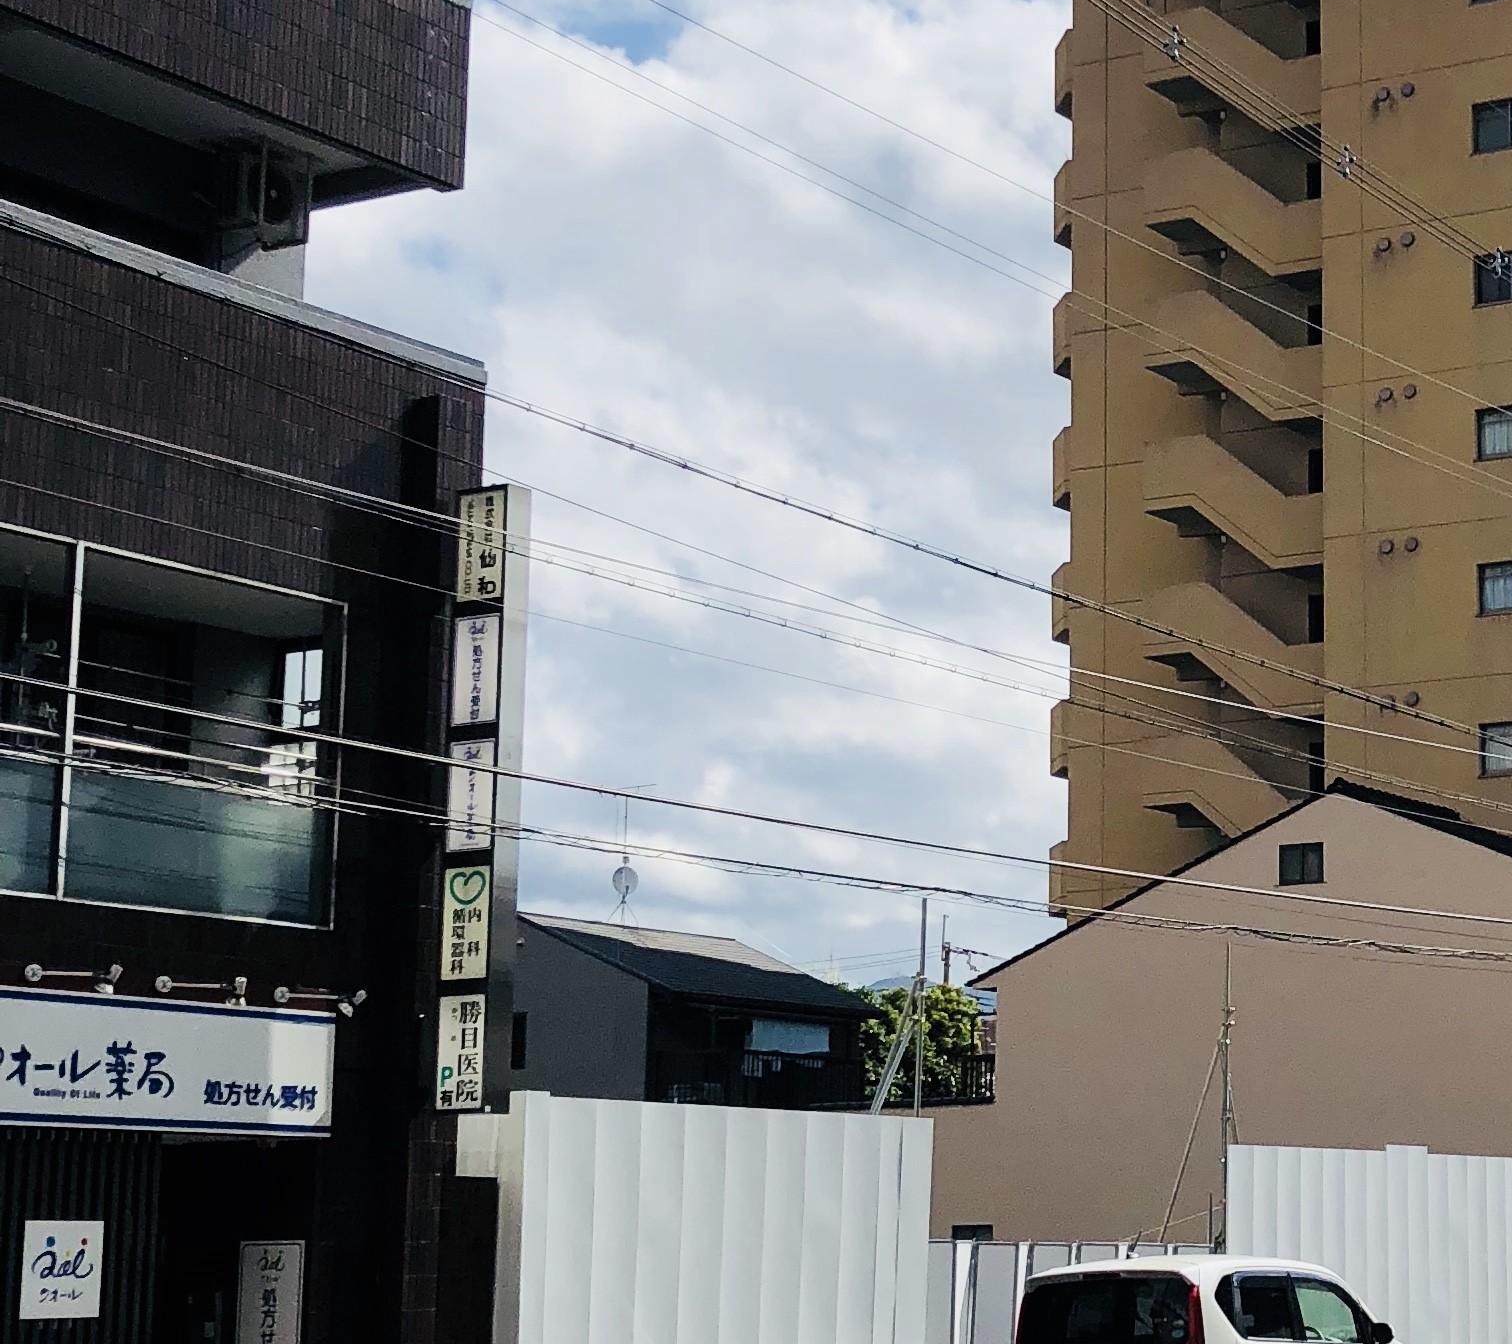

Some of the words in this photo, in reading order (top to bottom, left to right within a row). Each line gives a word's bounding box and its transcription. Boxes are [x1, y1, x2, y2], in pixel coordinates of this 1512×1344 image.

[468, 907, 482, 957] 内科
[0, 1040, 175, 1100] オール薬局
[456, 1001, 482, 1103] 勝目医院
[203, 1079, 318, 1111] 処方せん受付
